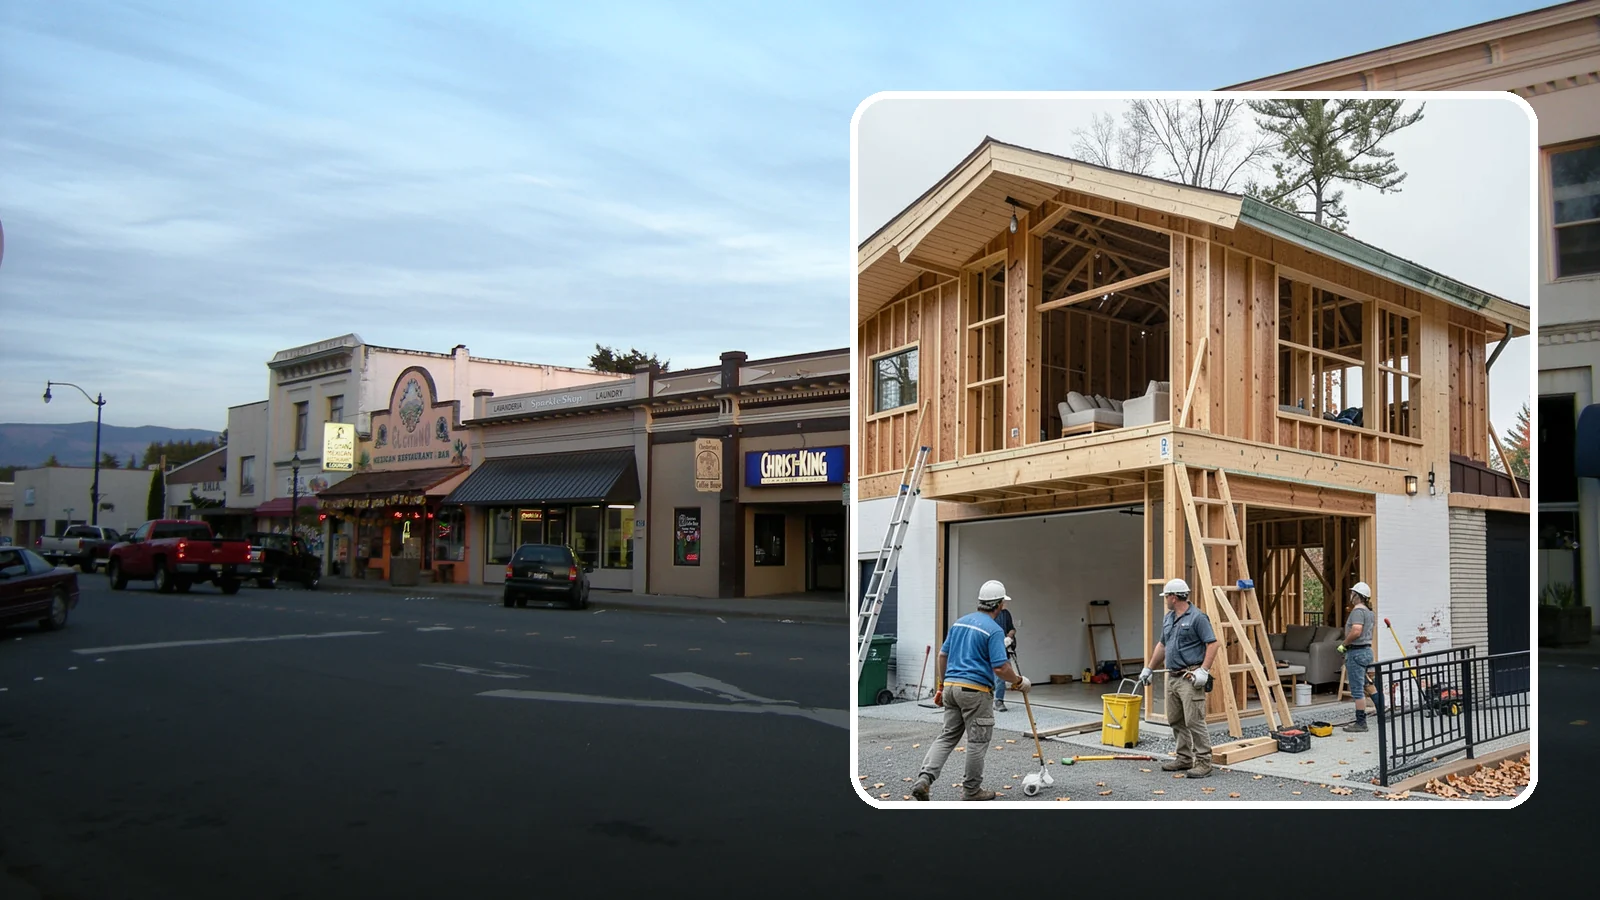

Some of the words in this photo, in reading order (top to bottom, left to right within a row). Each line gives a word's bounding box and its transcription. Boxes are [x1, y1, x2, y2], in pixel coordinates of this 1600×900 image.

[493, 402, 523, 412] LAVANDERIA
[531, 396, 561, 408] Sparkle
[561, 394, 583, 404] Shop
[595, 389, 623, 400] LAUNDRY
[373, 454, 396, 464] MEXICAN
[397, 451, 434, 462] RESTAURANT
[438, 450, 450, 459] BAR
[761, 452, 797, 478] CHRIST
[799, 450, 827, 476] KING
